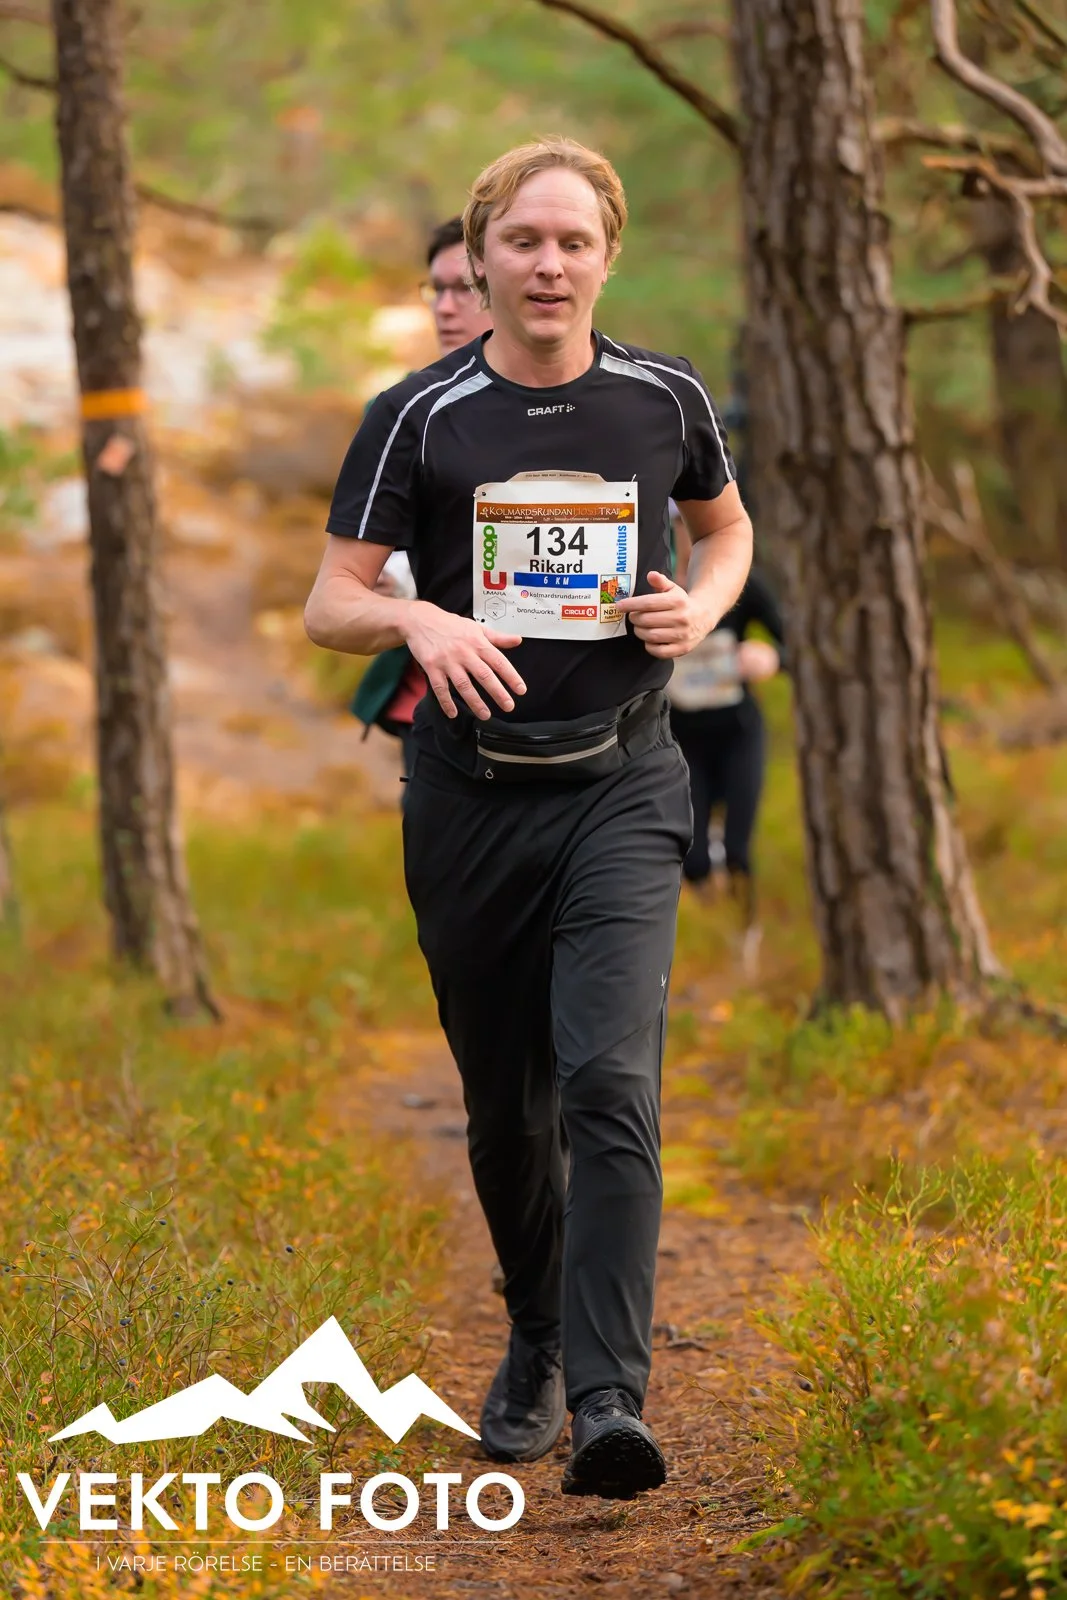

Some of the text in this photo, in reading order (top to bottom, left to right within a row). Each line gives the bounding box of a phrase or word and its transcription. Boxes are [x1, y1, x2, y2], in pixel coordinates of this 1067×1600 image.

[527, 404, 565, 417] CRAFT
[483, 524, 498, 571] coop
[526, 526, 589, 556] 134
[615, 525, 627, 573] Aktivitus
[529, 559, 583, 574] Rikard
[543, 576, 570, 586] 6 KM
[529, 591, 592, 600] kolmardsrundantrail
